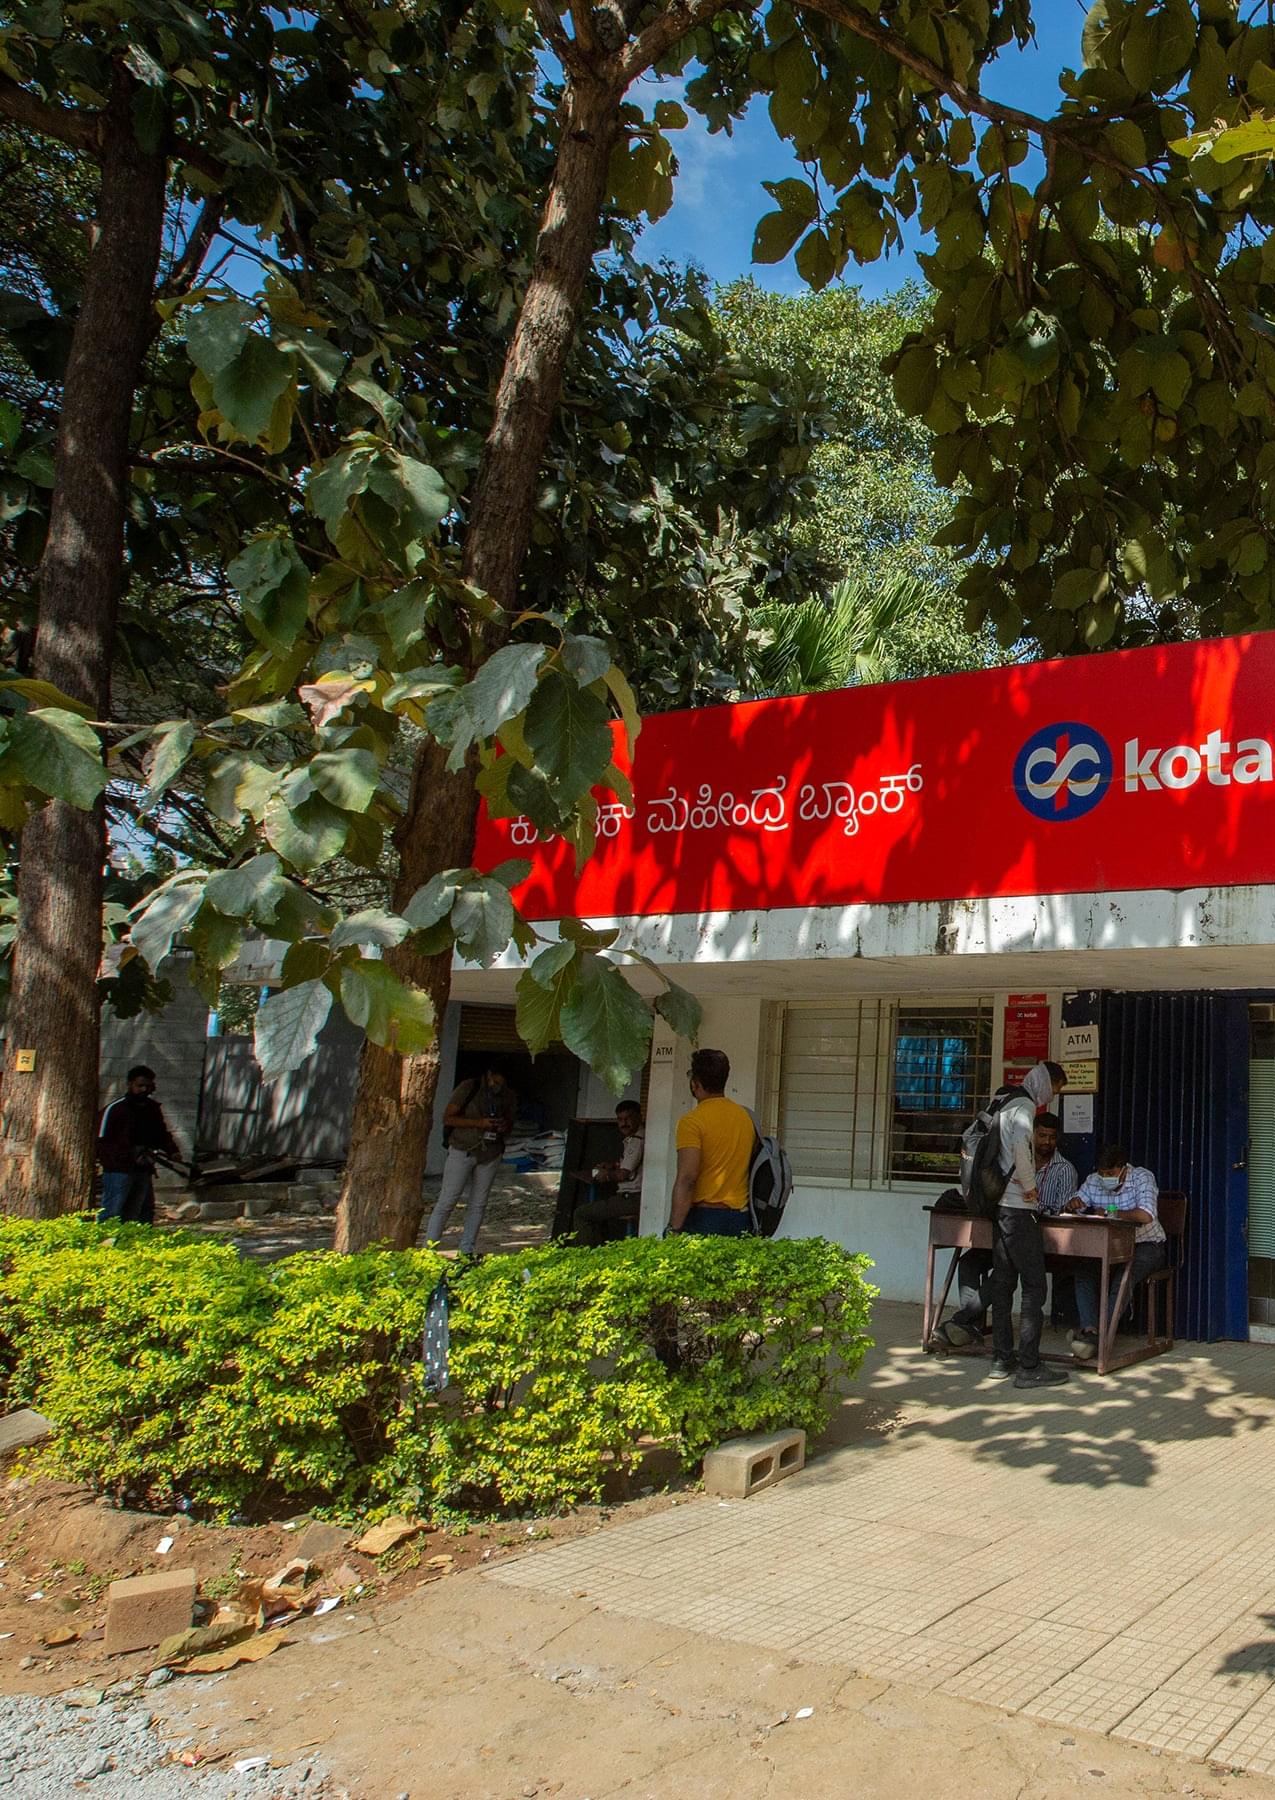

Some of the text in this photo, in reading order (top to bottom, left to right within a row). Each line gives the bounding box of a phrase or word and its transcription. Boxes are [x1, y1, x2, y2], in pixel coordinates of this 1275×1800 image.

[647, 775, 789, 833] ಮಹೀಂದ್ರ
[799, 763, 923, 836] ಬ್ಯಾಂಕ್
[1067, 1033, 1092, 1047] ATM
[655, 1047, 673, 1056] ATM
